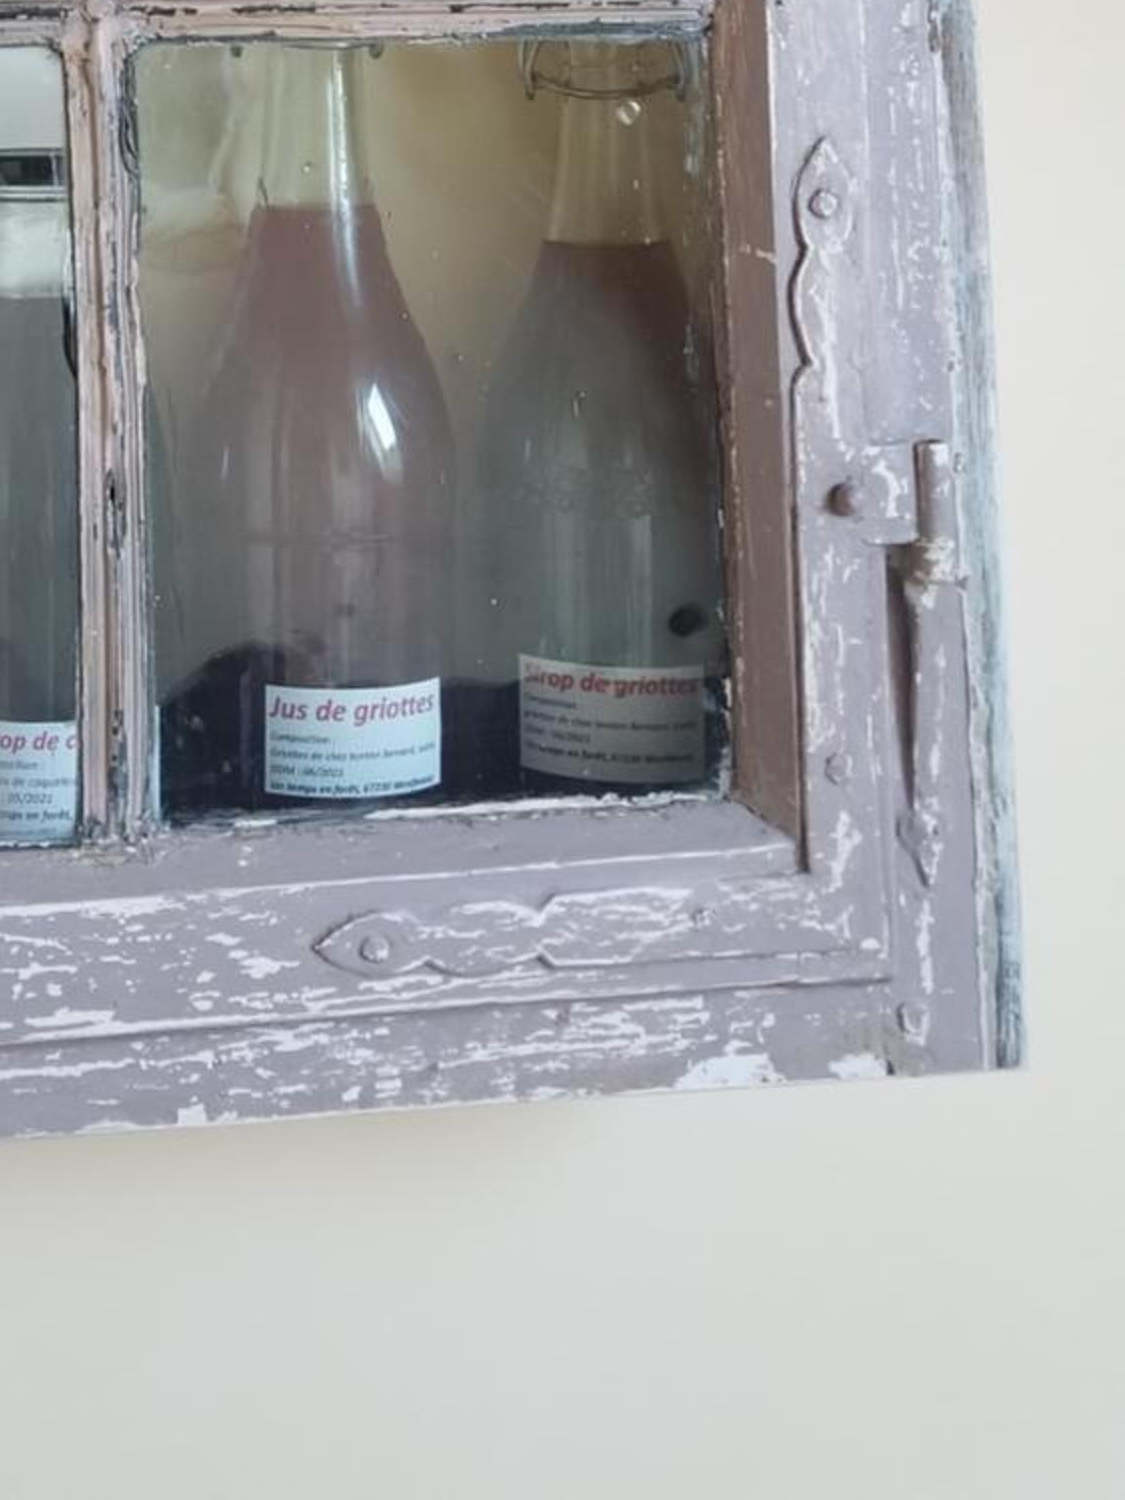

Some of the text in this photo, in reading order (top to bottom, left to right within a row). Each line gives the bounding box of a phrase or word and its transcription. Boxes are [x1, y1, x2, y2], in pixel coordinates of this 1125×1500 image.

[580, 672, 608, 693] de
[613, 677, 699, 698] griottes
[268, 692, 435, 728] Jus de griottes
[32, 730, 60, 751] de
